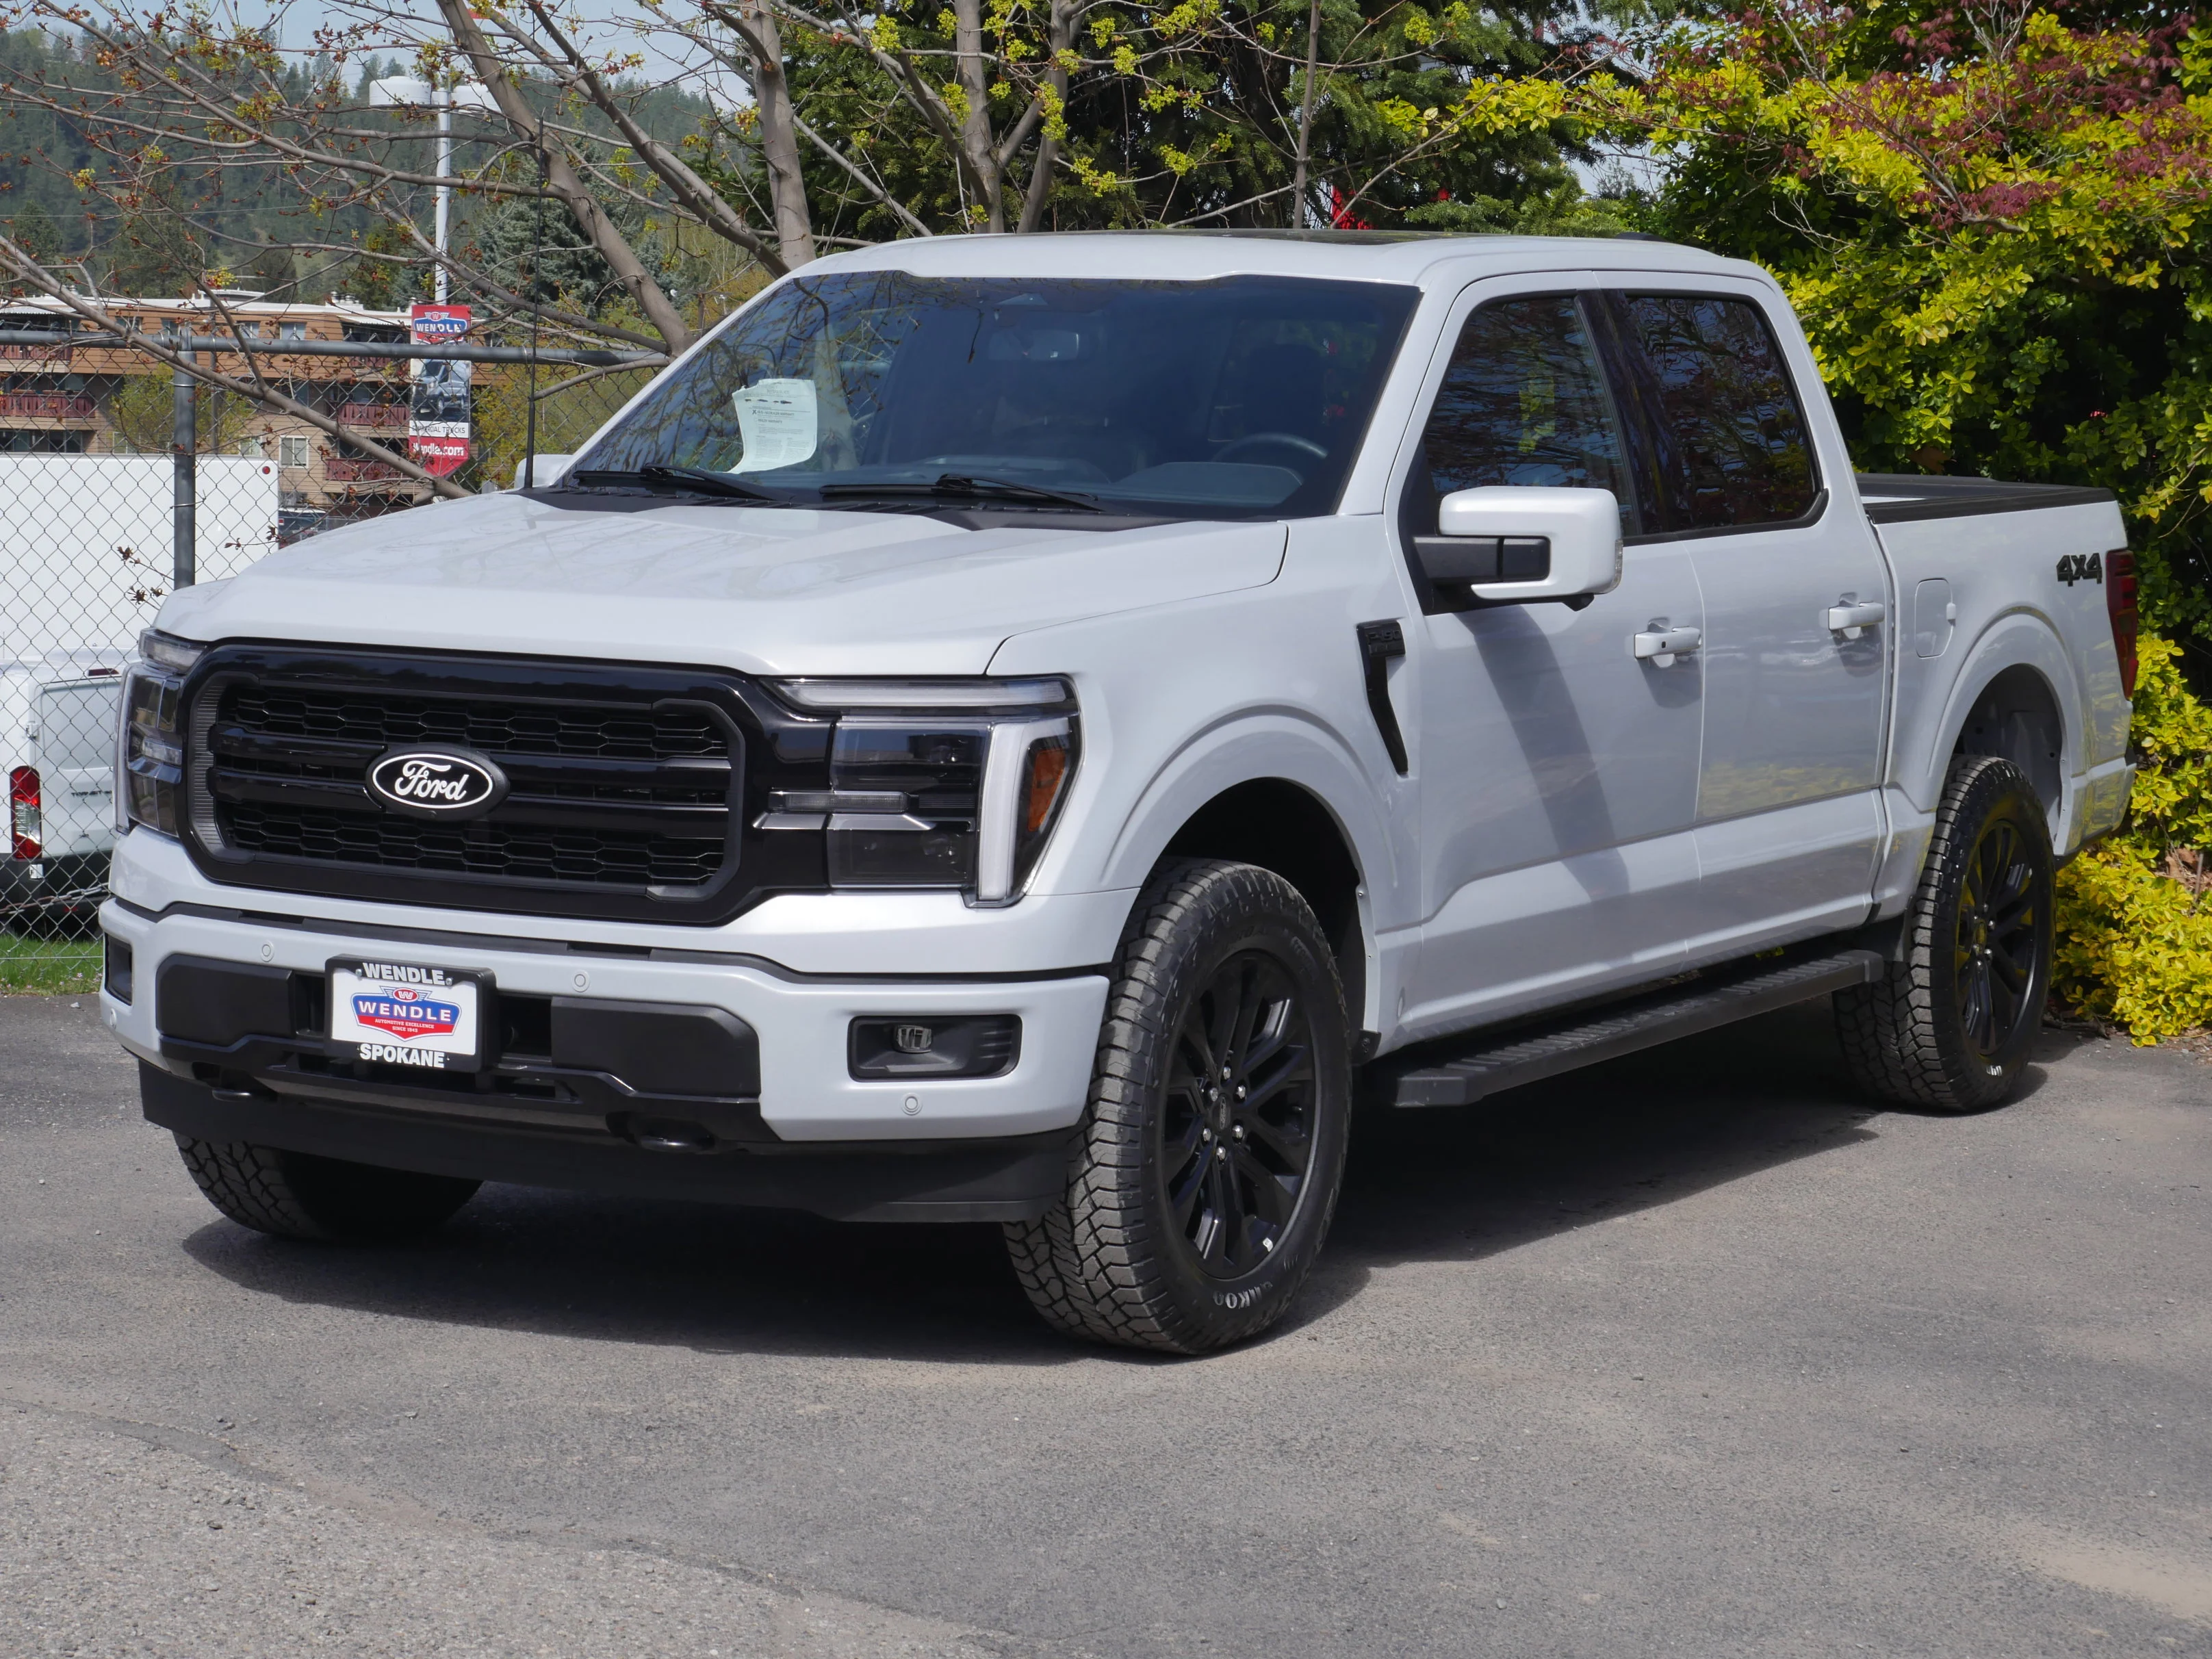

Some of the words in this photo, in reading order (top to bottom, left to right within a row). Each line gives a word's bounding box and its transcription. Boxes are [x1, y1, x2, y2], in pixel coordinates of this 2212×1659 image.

[416, 323, 461, 333] WENDLE
[394, 760, 470, 801] Ford
[362, 962, 446, 986] WENDLE
[398, 990, 414, 999] W
[358, 1001, 451, 1022] WENDLE
[359, 1043, 445, 1068] SPOKANE
